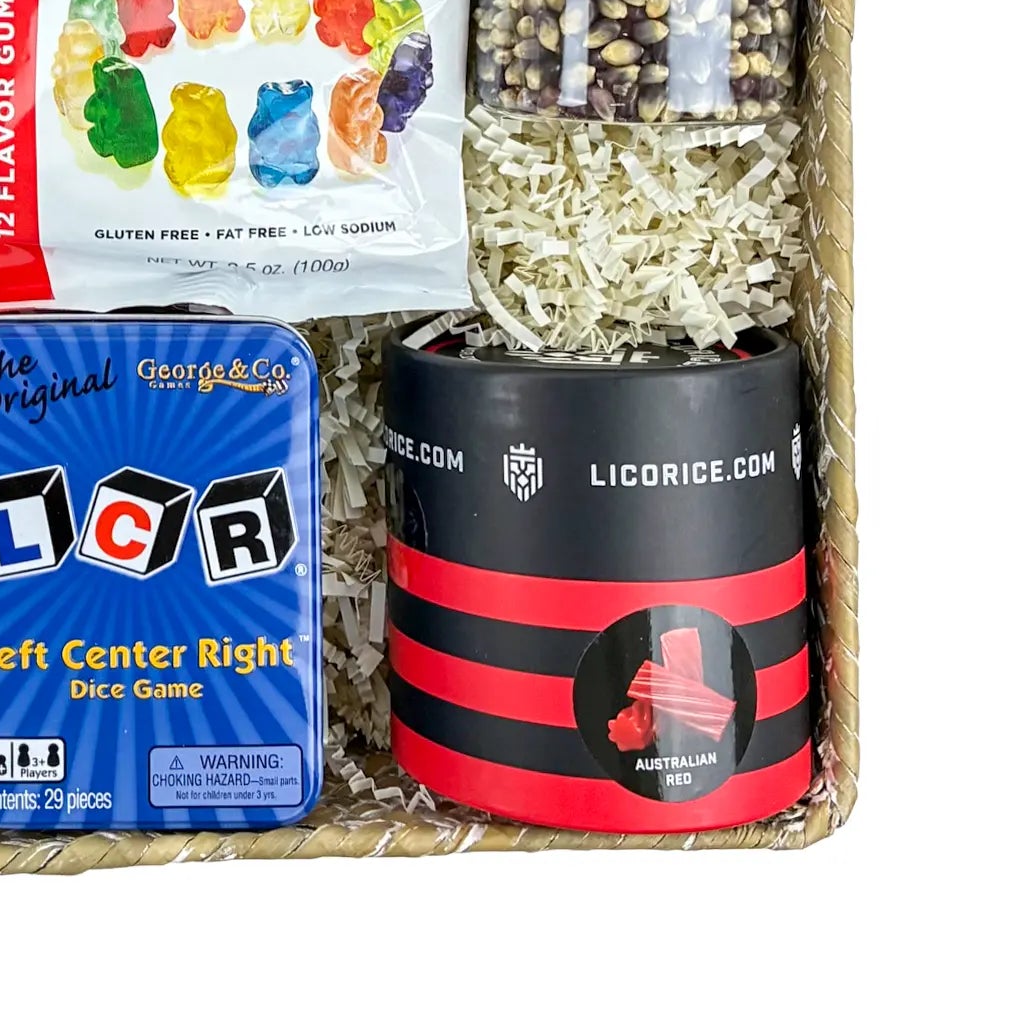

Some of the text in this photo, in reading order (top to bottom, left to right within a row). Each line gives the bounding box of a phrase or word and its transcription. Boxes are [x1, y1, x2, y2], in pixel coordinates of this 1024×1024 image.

[94, 221, 396, 240] GLUTEN FREE FAT FREE LOW SODIUM
[261, 264, 285, 275] oz.
[293, 259, 350, 275] (100g)
[149, 381, 191, 389] Games
[590, 450, 775, 487] LICORICE.COM
[62, 638, 186, 670] Center
[198, 636, 295, 674] Right
[69, 680, 204, 699] Dice Game
[199, 754, 284, 769] WARNING:
[635, 751, 717, 771] AUSTRALIAN
[20, 767, 58, 779] Players
[152, 773, 202, 787] CHOKING
[666, 772, 692, 786] RED
[44, 788, 64, 810] 29
[67, 788, 112, 813] pieces
[176, 790, 189, 799] Not
[191, 790, 201, 799] for
[203, 790, 232, 799] children
[233, 790, 255, 799] under
[257, 790, 262, 799] 3
